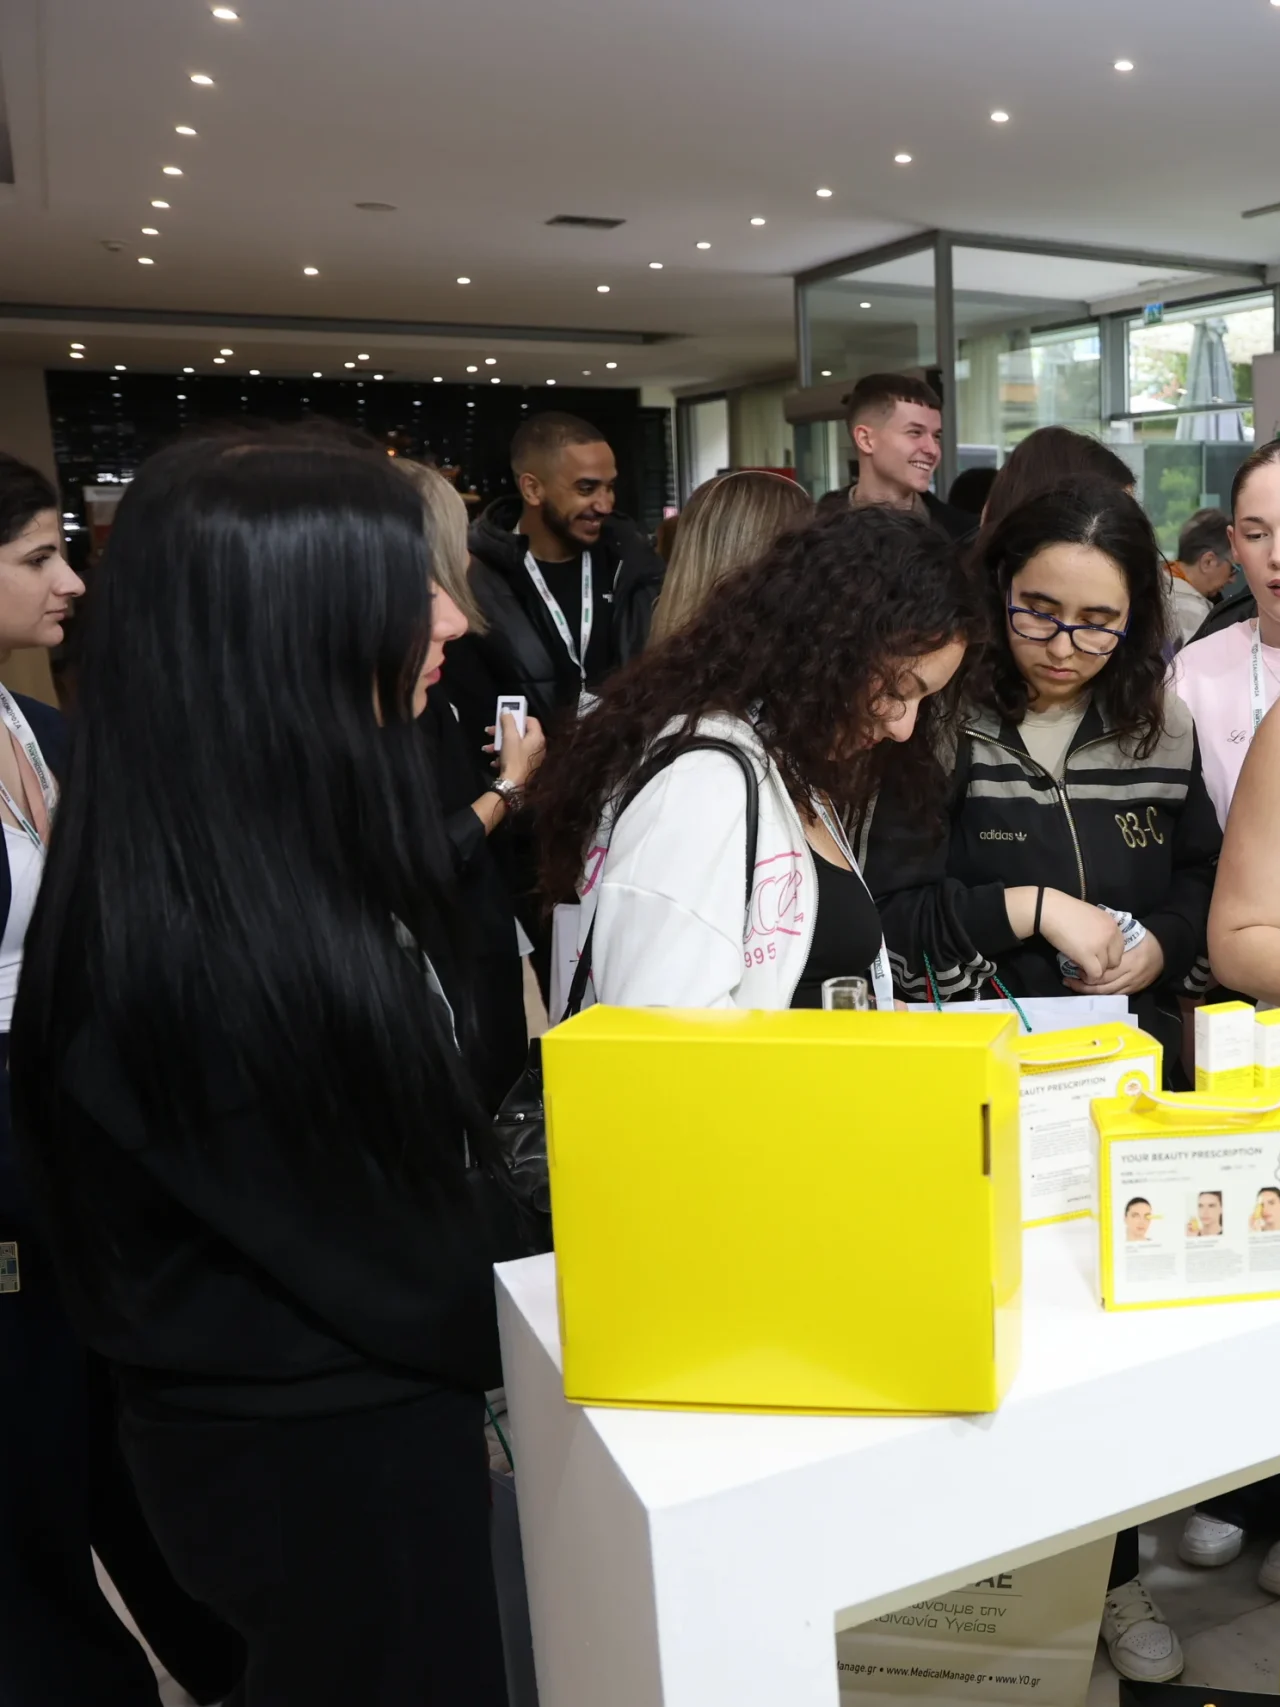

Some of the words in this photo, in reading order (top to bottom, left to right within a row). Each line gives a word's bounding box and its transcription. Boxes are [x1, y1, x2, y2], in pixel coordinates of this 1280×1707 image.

[980, 829, 1014, 840] adidas
[1019, 1087, 1045, 1097] EAUTY
[1121, 1153, 1149, 1163] YOUR
[1151, 1151, 1189, 1161] BEAUTY
[1191, 1147, 1263, 1158] PRESCRIPTION
[945, 1616, 997, 1634] Υγείας
[837, 1660, 877, 1675] anage.gr
[886, 1666, 987, 1683] www.MedicalManage.gr
